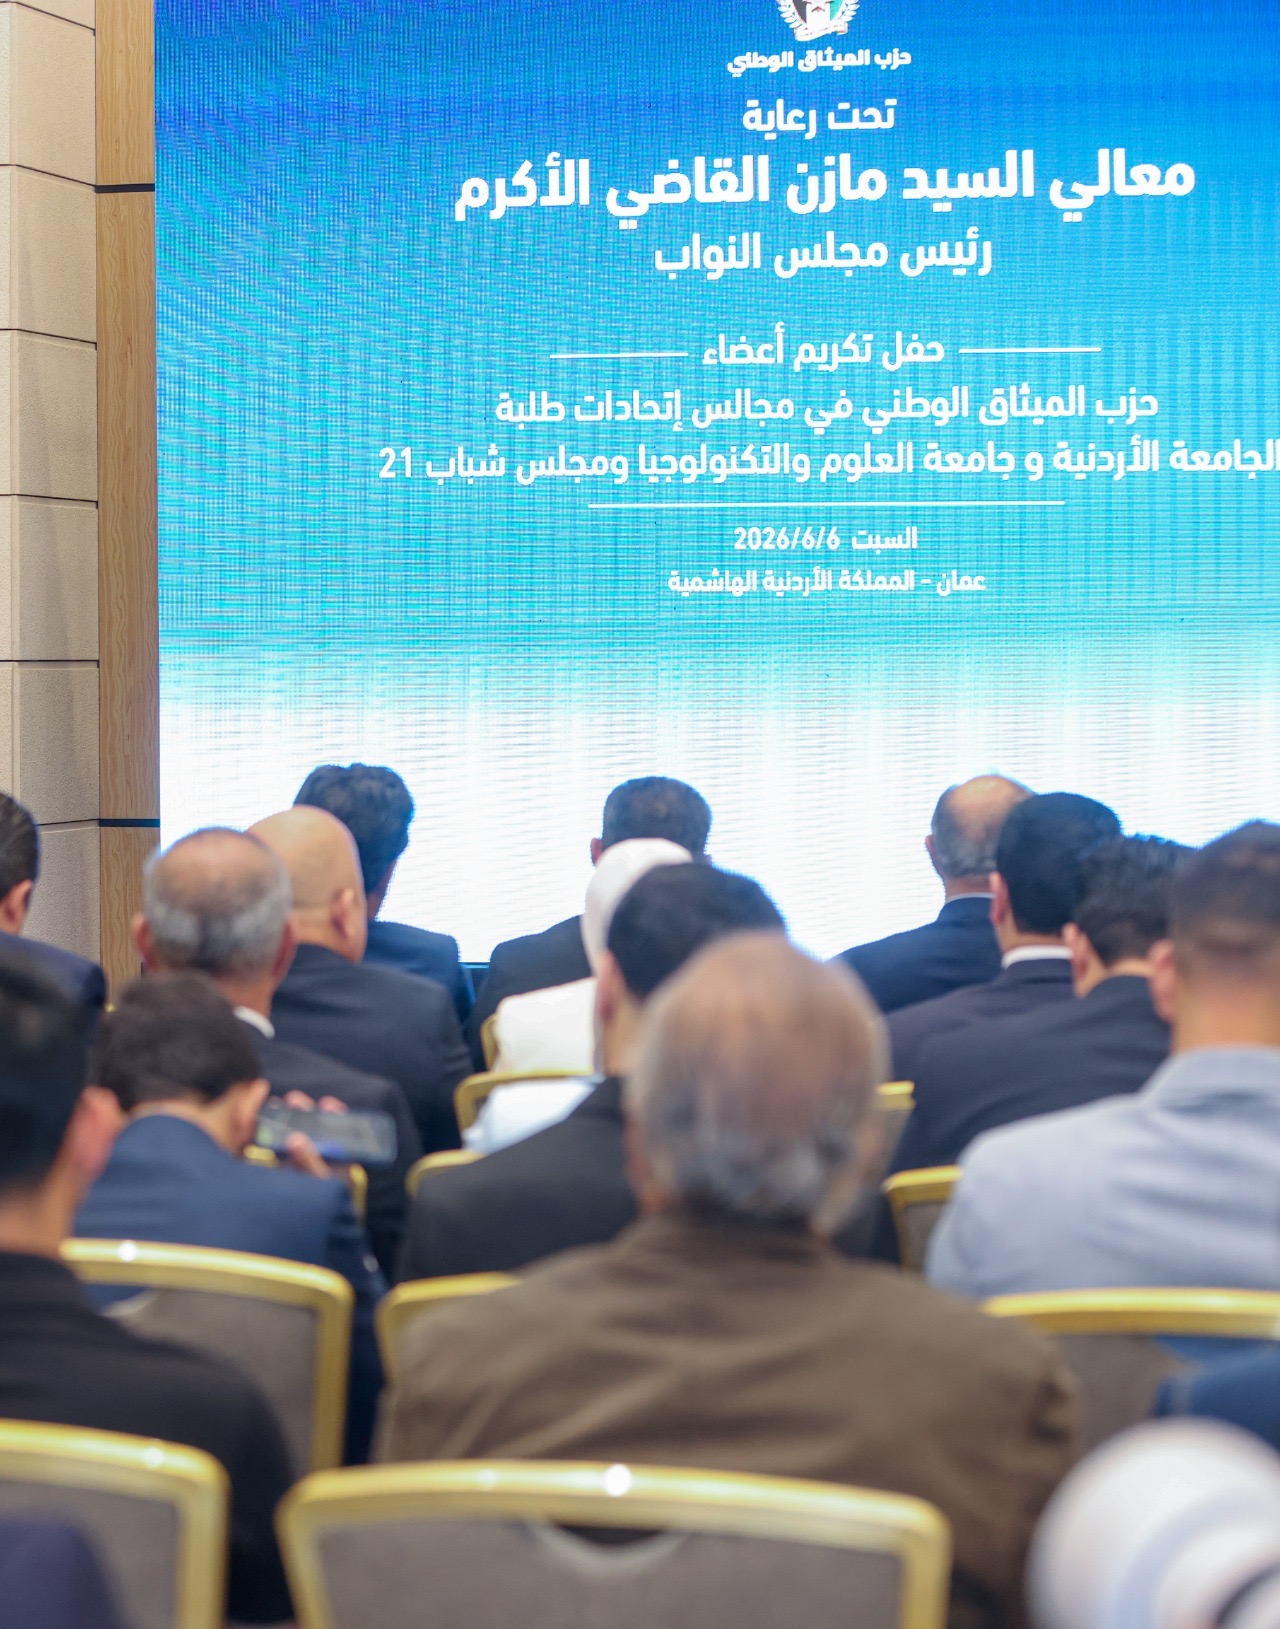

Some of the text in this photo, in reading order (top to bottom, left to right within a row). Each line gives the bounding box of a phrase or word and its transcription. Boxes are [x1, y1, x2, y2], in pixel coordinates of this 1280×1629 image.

[727, 46, 912, 78] حزب الميثاق الوطني
[742, 98, 898, 141] تحت رعاية
[454, 148, 1196, 229] معالي السيد مازن القاضي الأكرم
[654, 226, 993, 281] رئيس مجلس النواب
[702, 321, 946, 373] حفل تكريم أعضاء
[494, 382, 1159, 435] حزب الميثاق الوطني في مجالس إتحادات طلبة
[378, 446, 412, 479] 21
[425, 443, 506, 486] شباب
[515, 444, 630, 486] ومجلس
[637, 441, 811, 485] والتكنولوجيا
[819, 441, 914, 483] العلوم
[922, 440, 1016, 481] جامعة
[1024, 452, 1045, 482] و
[1052, 434, 1161, 481] الأردنية
[733, 525, 920, 555] السبت 2026/6/6
[667, 567, 758, 598] الهاشمية
[762, 565, 833, 597] الأردنية
[838, 568, 916, 593] المملكة
[935, 569, 988, 597] عمان
